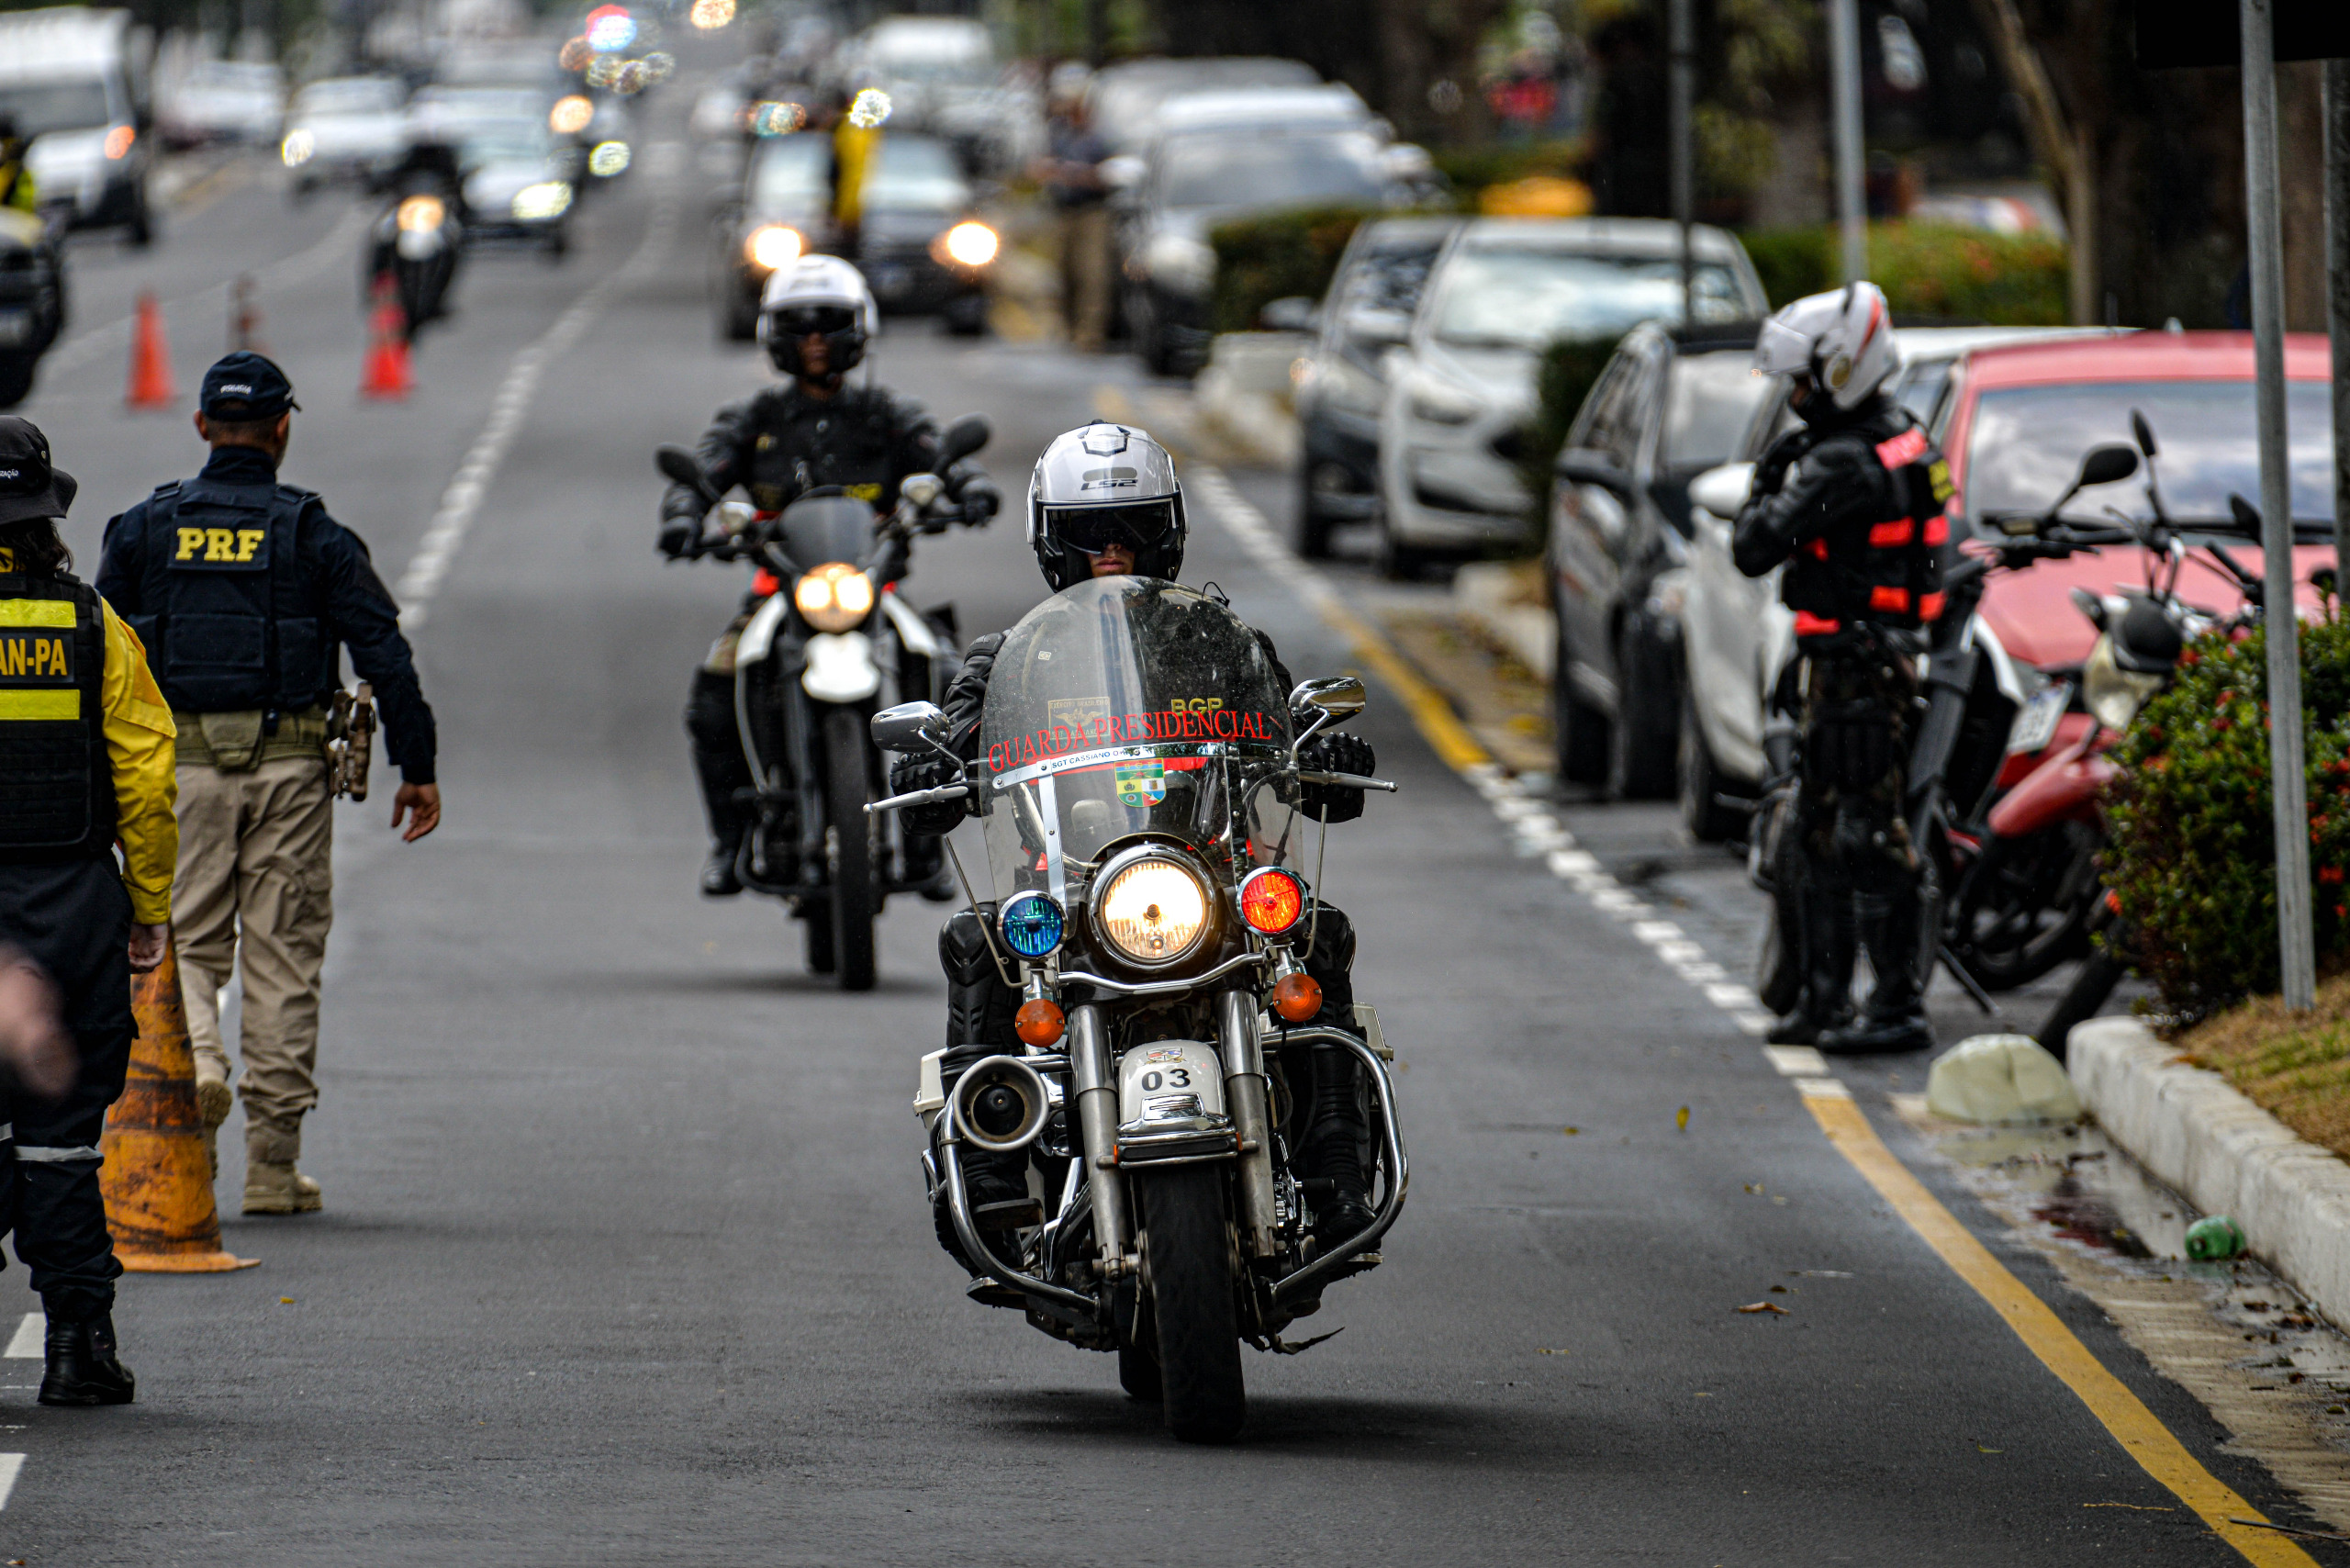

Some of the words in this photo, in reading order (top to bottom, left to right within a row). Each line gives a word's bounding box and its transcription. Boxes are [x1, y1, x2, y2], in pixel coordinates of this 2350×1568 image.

[1080, 478, 1137, 490] LS2
[175, 527, 264, 561] PRF
[1170, 697, 1224, 717] BGP
[988, 721, 1091, 772] GUARDA
[1093, 710, 1272, 745] PRESIDENCIAL
[1052, 759, 1067, 768] SGT
[1069, 751, 1111, 764] CASSIANO
[1141, 1068, 1192, 1092] 03
